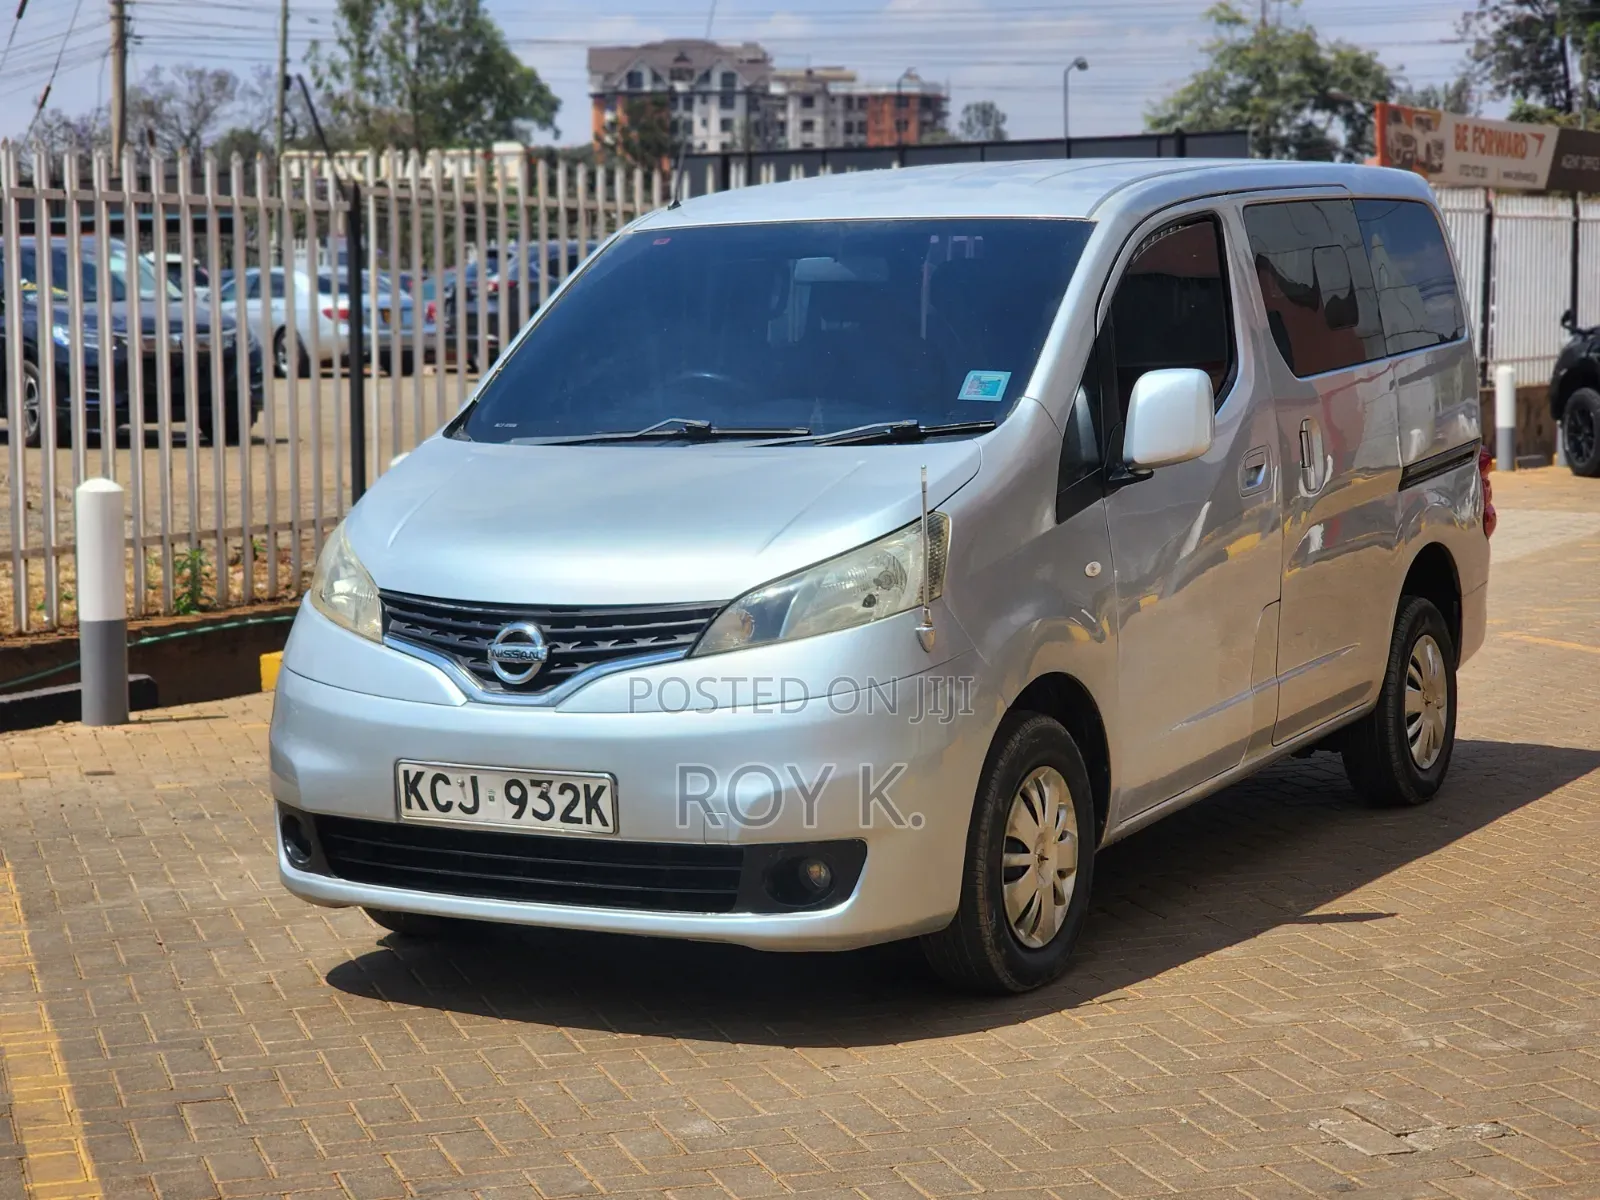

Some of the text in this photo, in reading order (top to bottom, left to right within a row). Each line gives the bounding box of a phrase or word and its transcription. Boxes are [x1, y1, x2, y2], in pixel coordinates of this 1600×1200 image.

[1455, 124, 1528, 160] BE FORWARD
[491, 648, 541, 660] NISSAN
[403, 769, 609, 827] KCJ 932K
